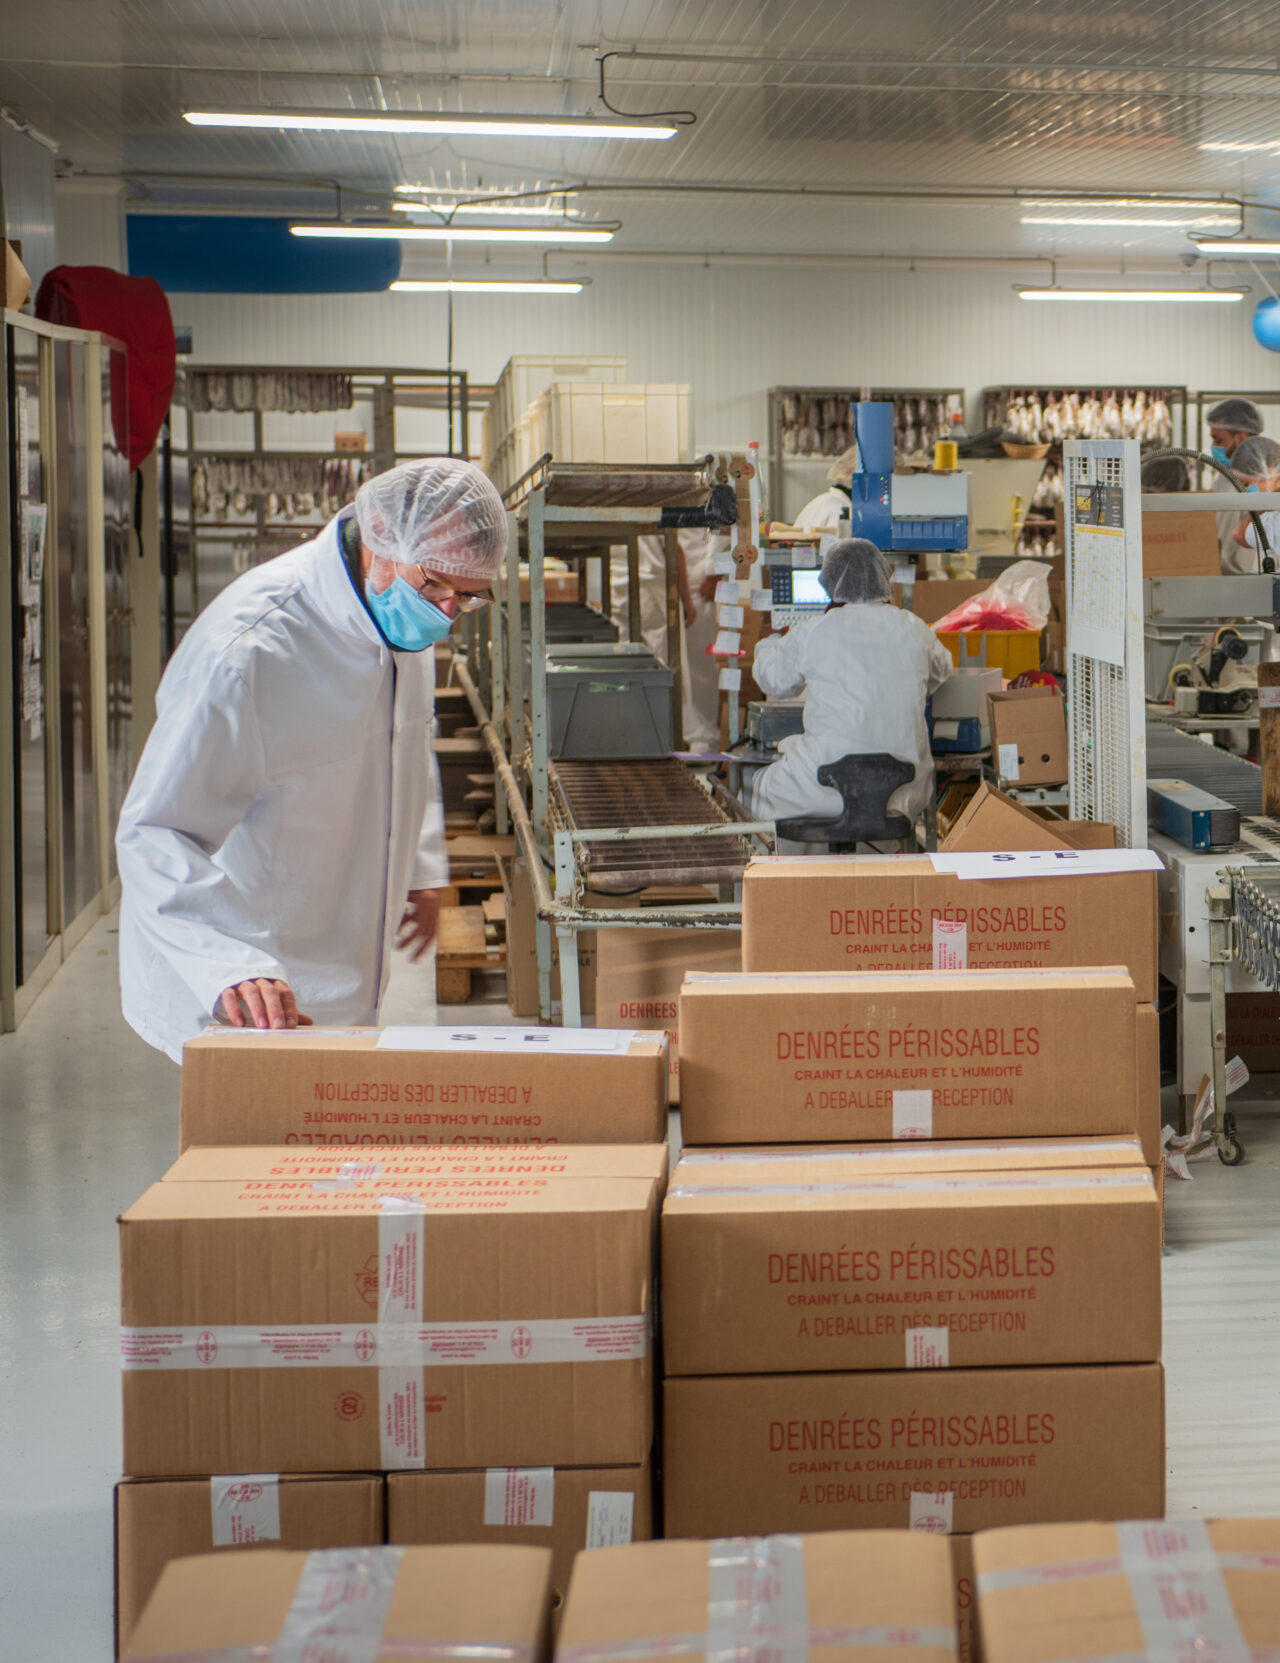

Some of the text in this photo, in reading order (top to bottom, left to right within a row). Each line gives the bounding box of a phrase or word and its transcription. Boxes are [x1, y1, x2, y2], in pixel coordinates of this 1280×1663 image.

[992, 853, 1016, 862] S
[830, 902, 922, 935] DENRÉES
[846, 944, 888, 954] CRAINT
[892, 943, 908, 953] LA
[969, 942, 983, 951] ET
[620, 1002, 677, 1019] DENREES
[450, 1033, 477, 1041] S
[777, 1022, 1040, 1060] DENRÉES PÉRISSABLES
[794, 1064, 1023, 1080] CRAINT LA CHALEUR ET L'HUMIDITÉ
[315, 1082, 399, 1101] RECEPTION
[440, 1084, 517, 1104] DEBALLER
[522, 1086, 532, 1104] A
[805, 1087, 1014, 1110] A DEBALLER RECEPTION
[383, 1113, 399, 1124] ET
[404, 1114, 468, 1125] CHALEUR
[471, 1115, 489, 1125] LA
[492, 1115, 541, 1126] CRAINT
[244, 1182, 364, 1190] DENRS
[768, 1242, 1055, 1284] DENRÉES PÉRISSABLES
[787, 1286, 1037, 1306] CRAINT LA CHALEUR ET L'HUMIDITÉ
[798, 1317, 810, 1336] A
[814, 1315, 896, 1337] DEBALLER
[938, 1311, 1025, 1332] RECEPTION
[769, 1409, 1055, 1452] DENRÉES PÉRISSABLES
[787, 1453, 1037, 1474] CRAINT LA CHALEUR ET L'HUMIDITÉ
[798, 1485, 810, 1504] A
[815, 1482, 896, 1504] DEBALLER
[938, 1478, 1026, 1500] RECEPTION
